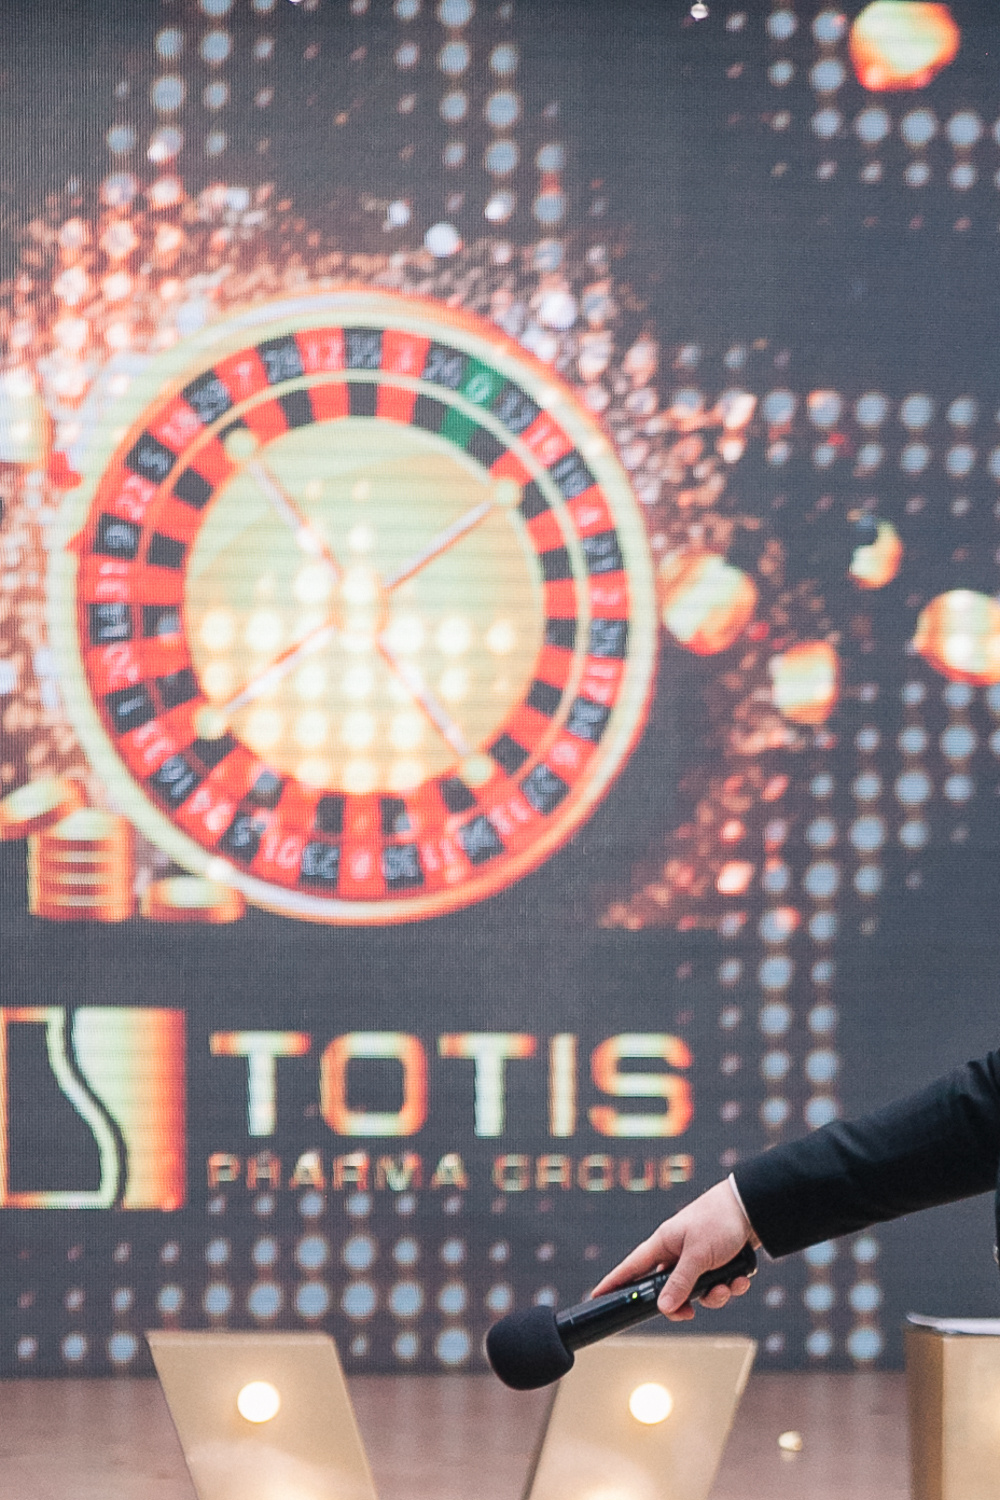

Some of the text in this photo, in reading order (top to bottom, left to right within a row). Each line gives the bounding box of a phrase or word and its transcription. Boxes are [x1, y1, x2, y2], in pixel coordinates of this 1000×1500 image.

[209, 1030, 695, 1138] TOTIS
[207, 1151, 695, 1192] PHARMA GROUP
